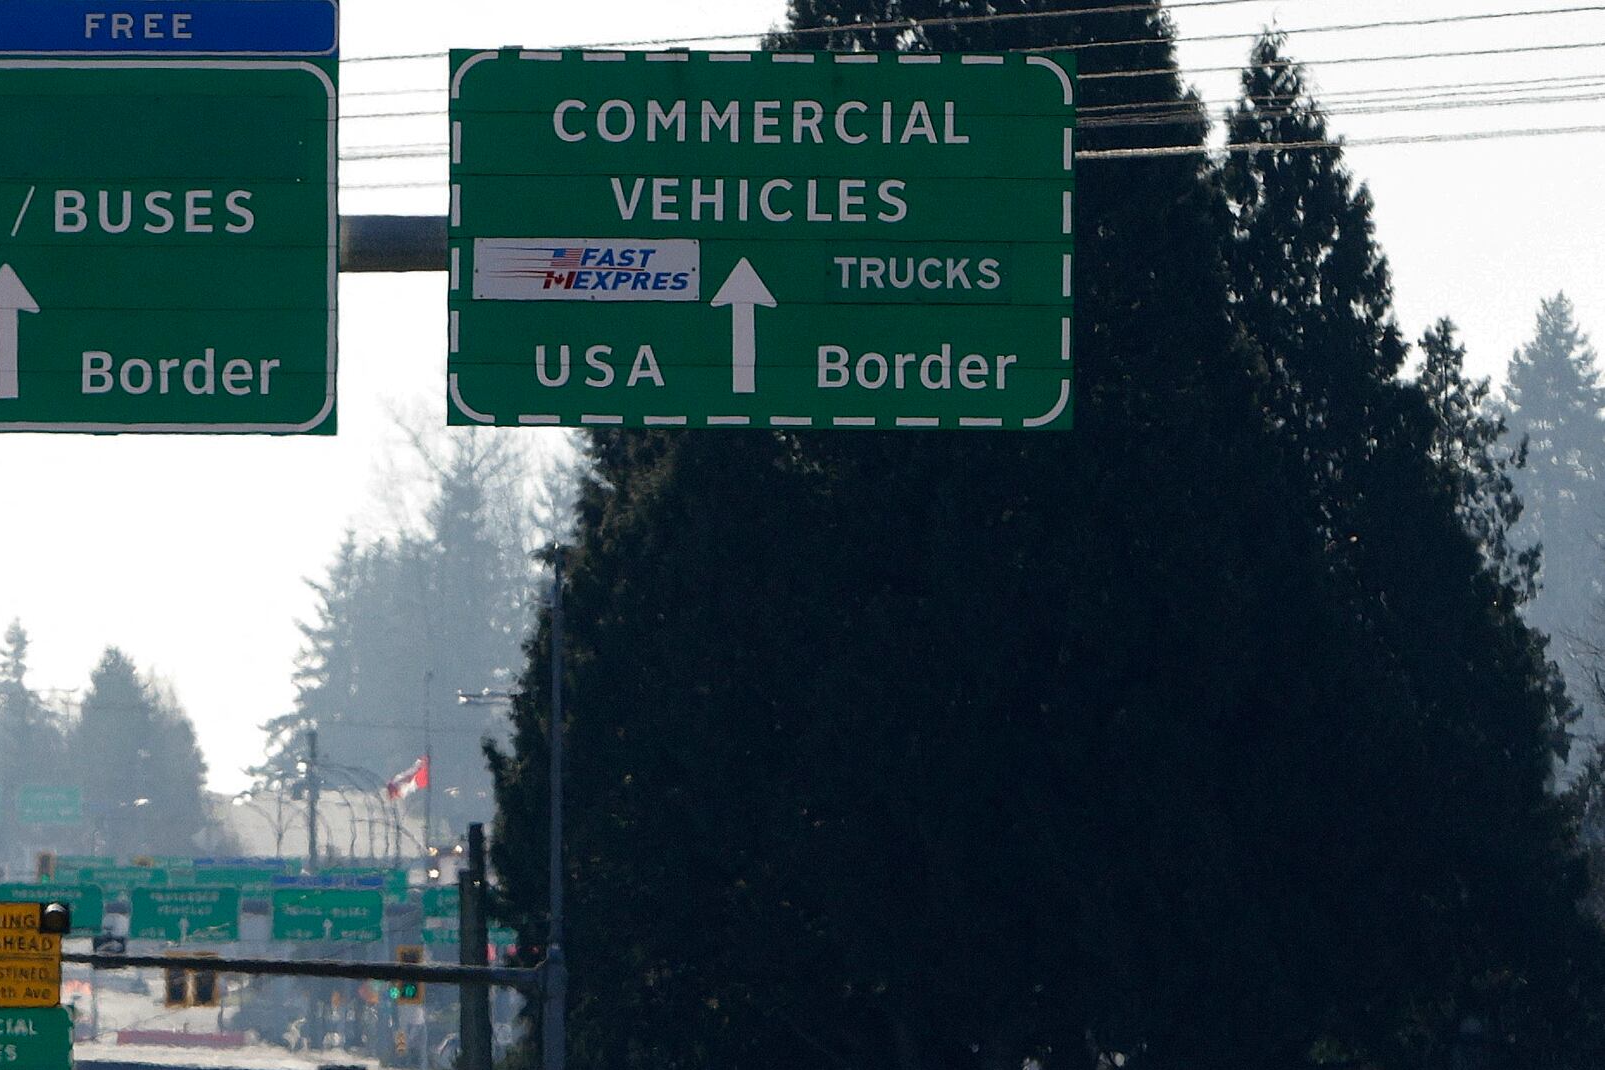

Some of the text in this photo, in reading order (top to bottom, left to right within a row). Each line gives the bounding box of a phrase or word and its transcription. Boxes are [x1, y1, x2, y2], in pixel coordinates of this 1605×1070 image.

[84, 13, 194, 40] FREE
[552, 98, 970, 145] COMMERCIAL
[54, 189, 256, 235] BUSES
[611, 177, 909, 223] VEHICLES
[572, 270, 691, 292] EXPRES
[579, 248, 657, 270] FAST
[834, 256, 1001, 290] TRUCKS
[81, 347, 281, 396] Border
[535, 343, 1017, 390] USA Border
